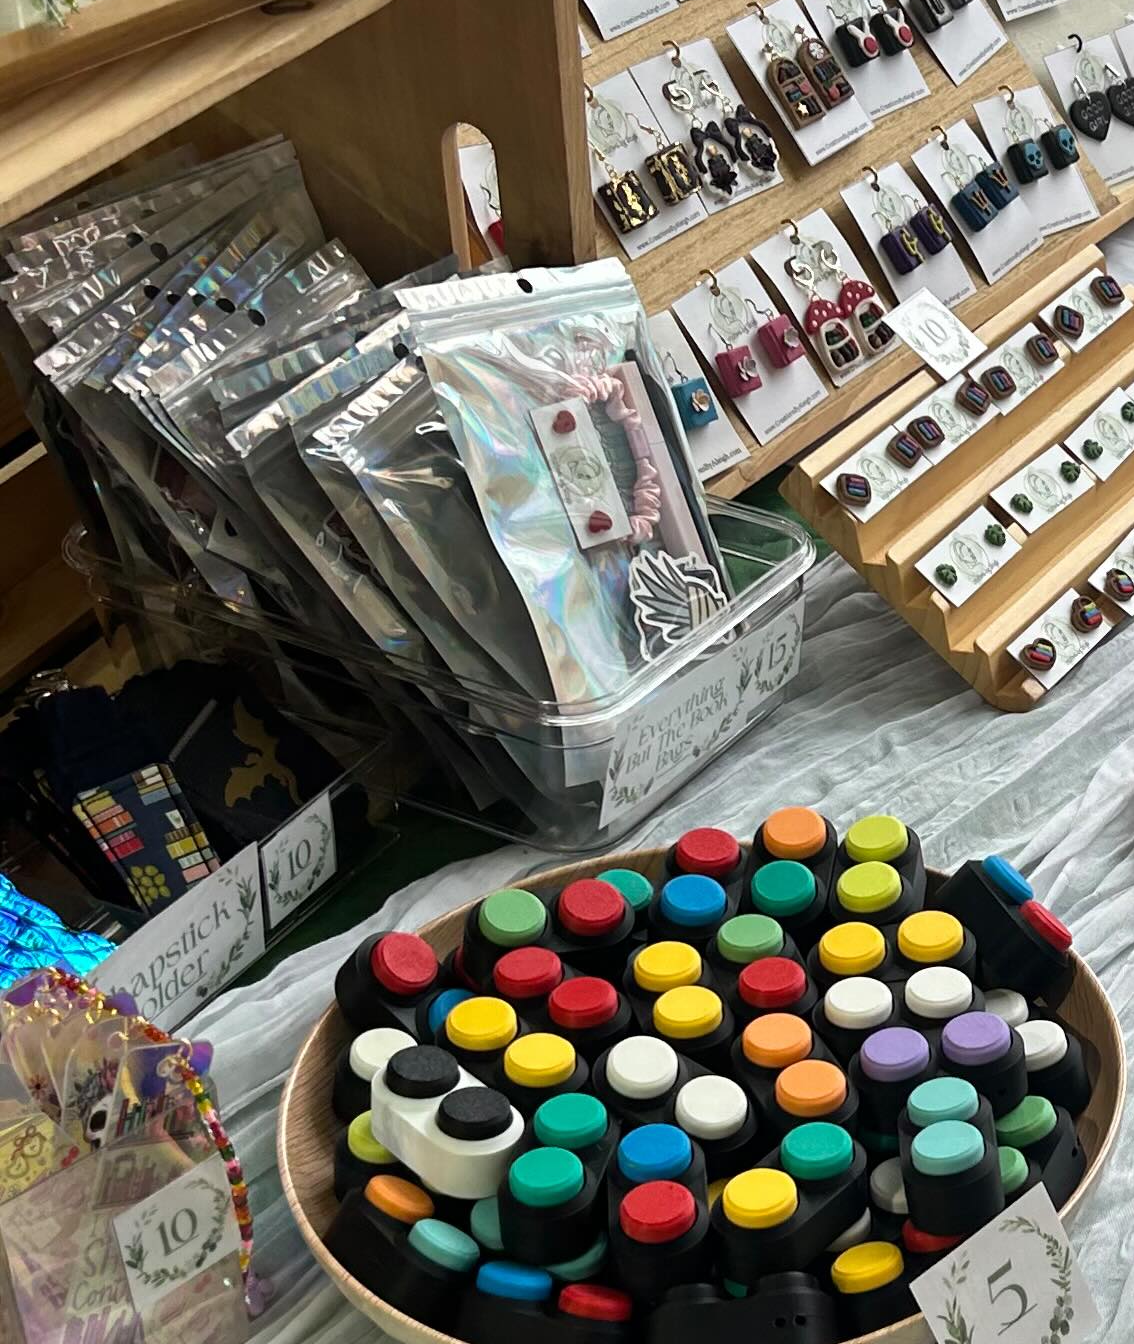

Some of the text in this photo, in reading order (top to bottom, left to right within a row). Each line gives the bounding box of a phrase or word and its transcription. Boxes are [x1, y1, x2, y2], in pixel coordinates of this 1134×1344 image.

[919, 319, 948, 346] 10
[768, 633, 788, 670] 15
[639, 677, 725, 746] Everything
[658, 722, 685, 753] The
[288, 839, 312, 881] 10
[108, 899, 231, 997] hapstick
[141, 948, 210, 1020] older
[155, 1207, 200, 1256] 10
[987, 1258, 1028, 1327] 5
